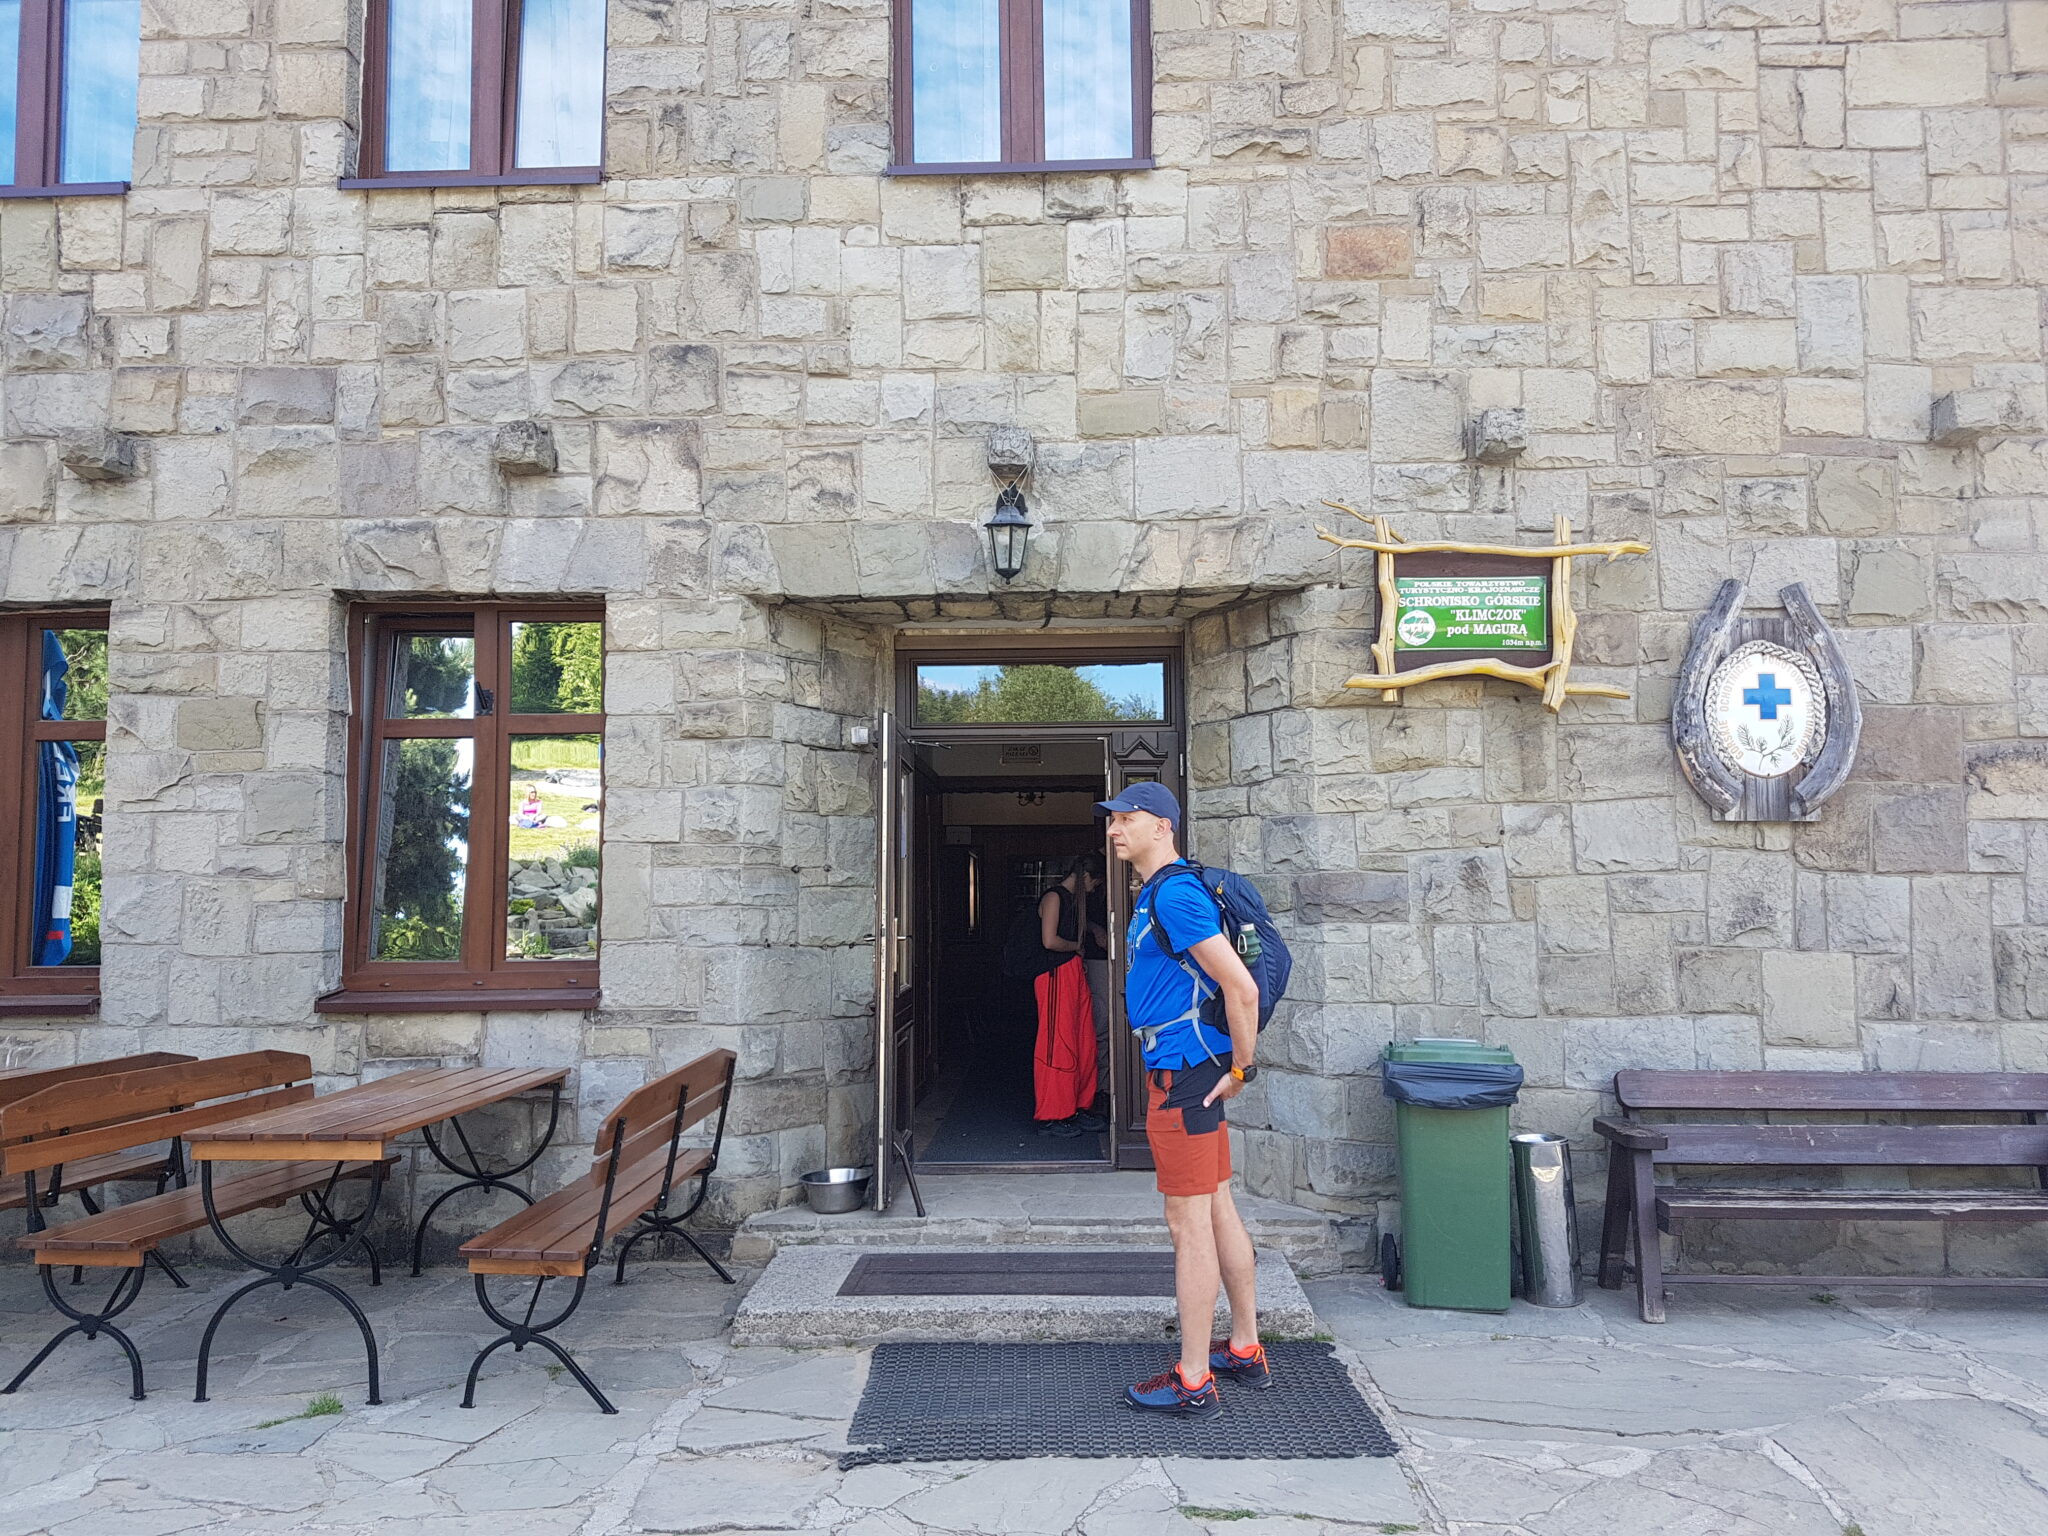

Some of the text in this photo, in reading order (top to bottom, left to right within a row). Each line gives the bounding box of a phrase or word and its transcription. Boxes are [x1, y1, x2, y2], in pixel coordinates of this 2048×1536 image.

[1398, 593, 1541, 607] SCHRONISKO GÓRSKIE
[1450, 609, 1527, 621] "KLIMCZOK"
[1446, 623, 1528, 637] pod MAGURĄ
